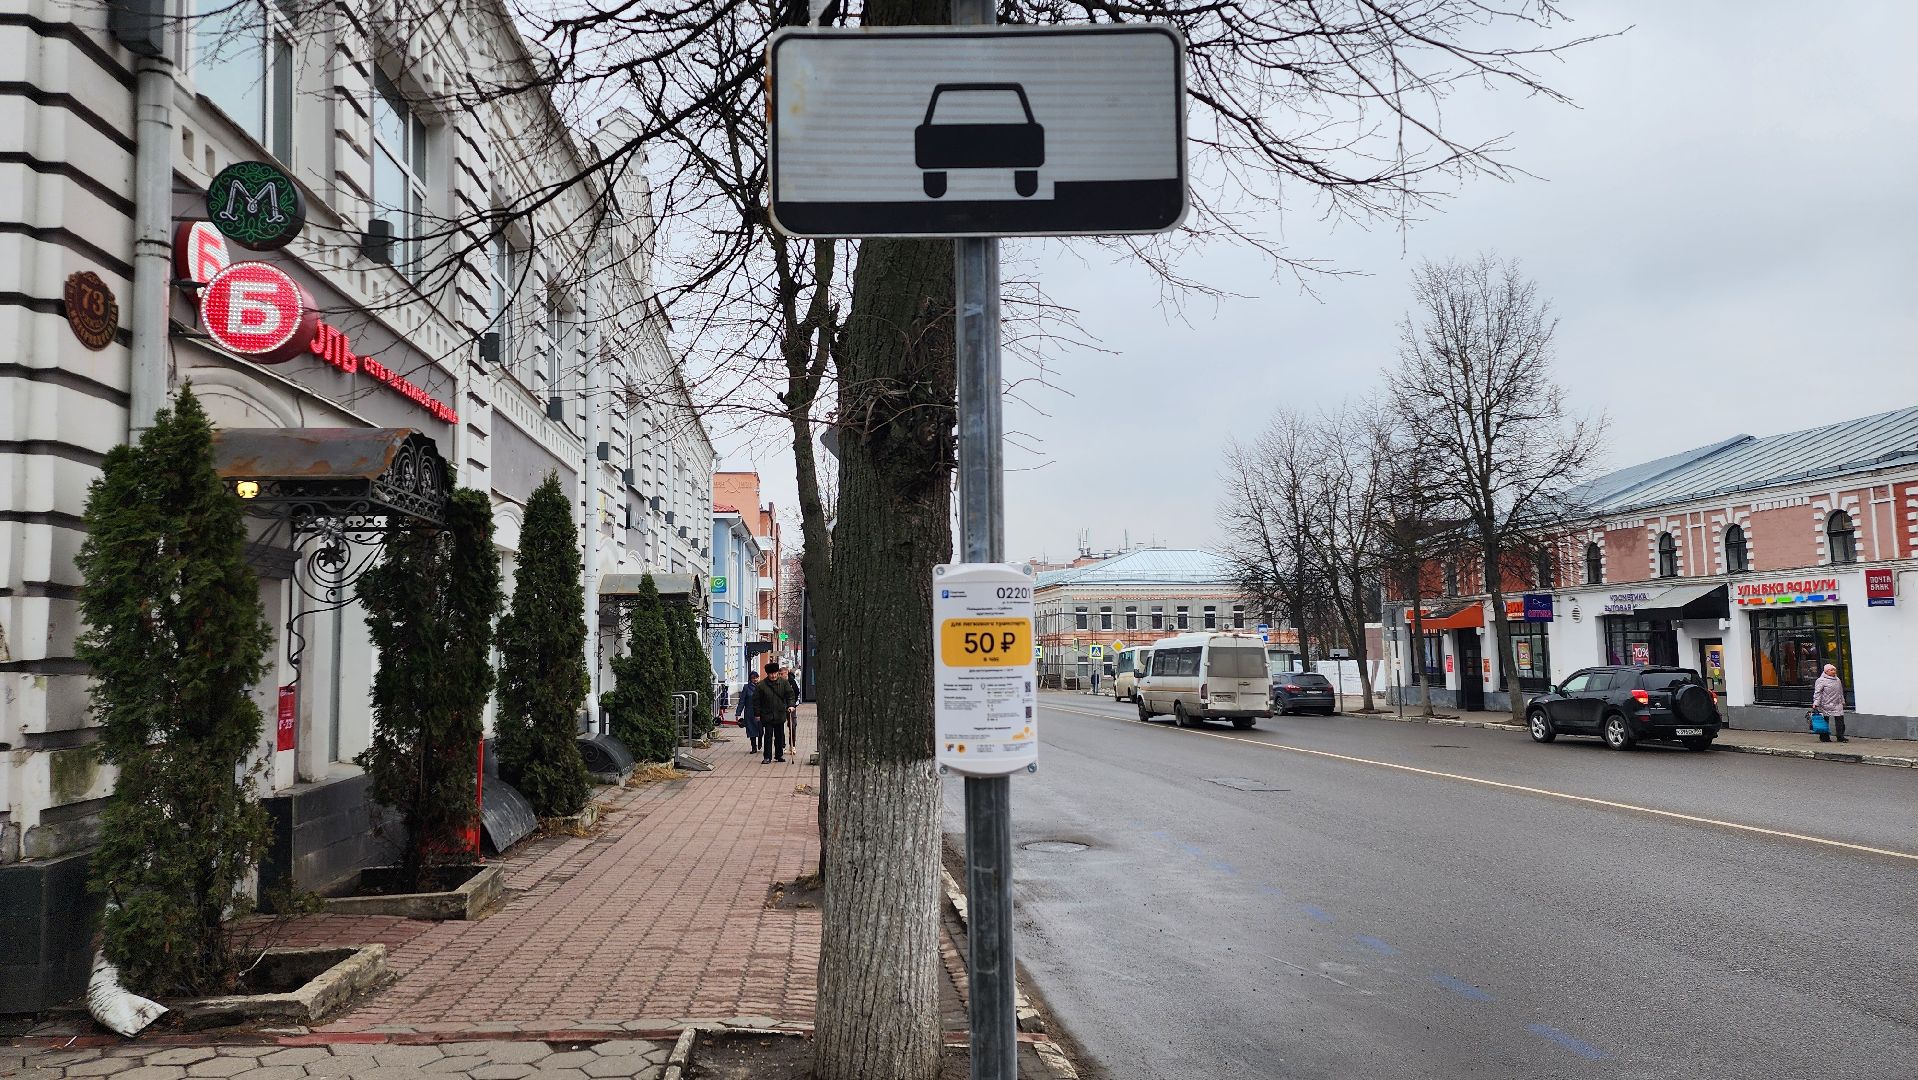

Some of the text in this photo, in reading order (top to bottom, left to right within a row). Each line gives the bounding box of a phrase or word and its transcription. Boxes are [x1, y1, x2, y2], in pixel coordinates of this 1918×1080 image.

[80, 283, 105, 316] 73
[227, 281, 281, 334] Б
[364, 356, 386, 381] СЕТЬ
[1870, 575, 1892, 583] ПОЧТА
[1870, 583, 1889, 591] БАНК
[964, 632, 1016, 653] 50 ₽
[1632, 647, 1649, 658] -10%
